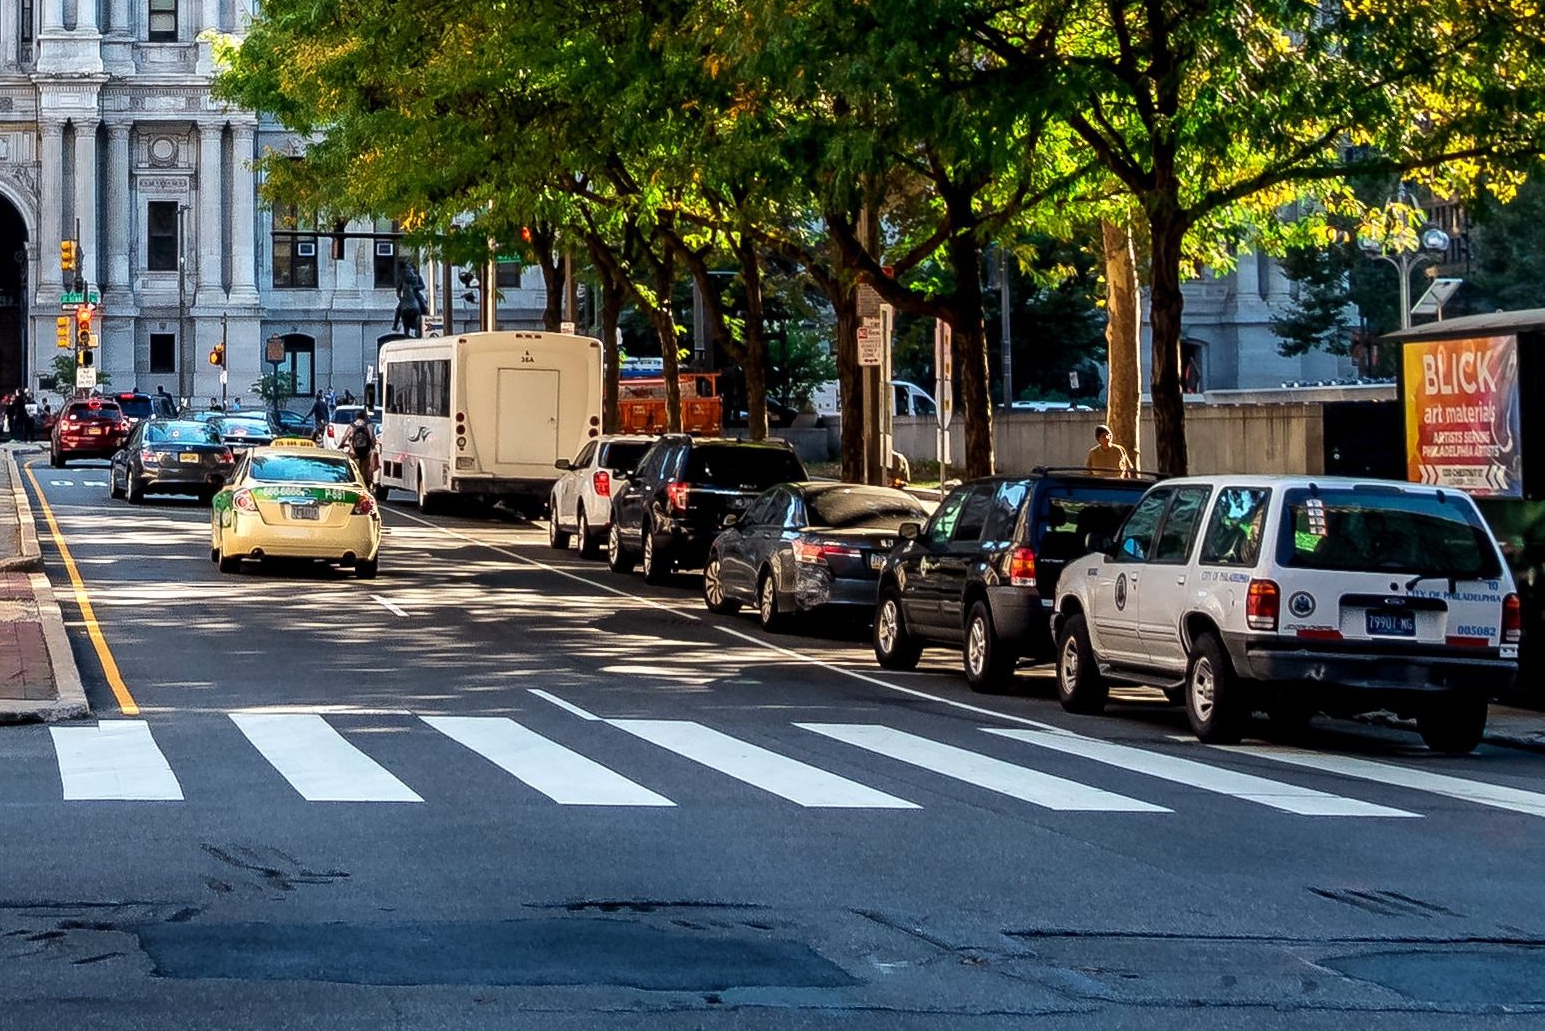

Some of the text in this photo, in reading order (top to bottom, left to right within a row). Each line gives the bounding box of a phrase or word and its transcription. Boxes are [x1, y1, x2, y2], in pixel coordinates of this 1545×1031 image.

[1422, 351, 1497, 396] BLICK
[1423, 399, 1496, 424] art materials
[1433, 431, 1491, 444] ARTISTS SERVING
[1422, 444, 1500, 458] PHILADELPHIA ARTISTS
[1406, 589, 1502, 603] CITY OF PHILADELPHIA
[1457, 625, 1497, 637] 005082
